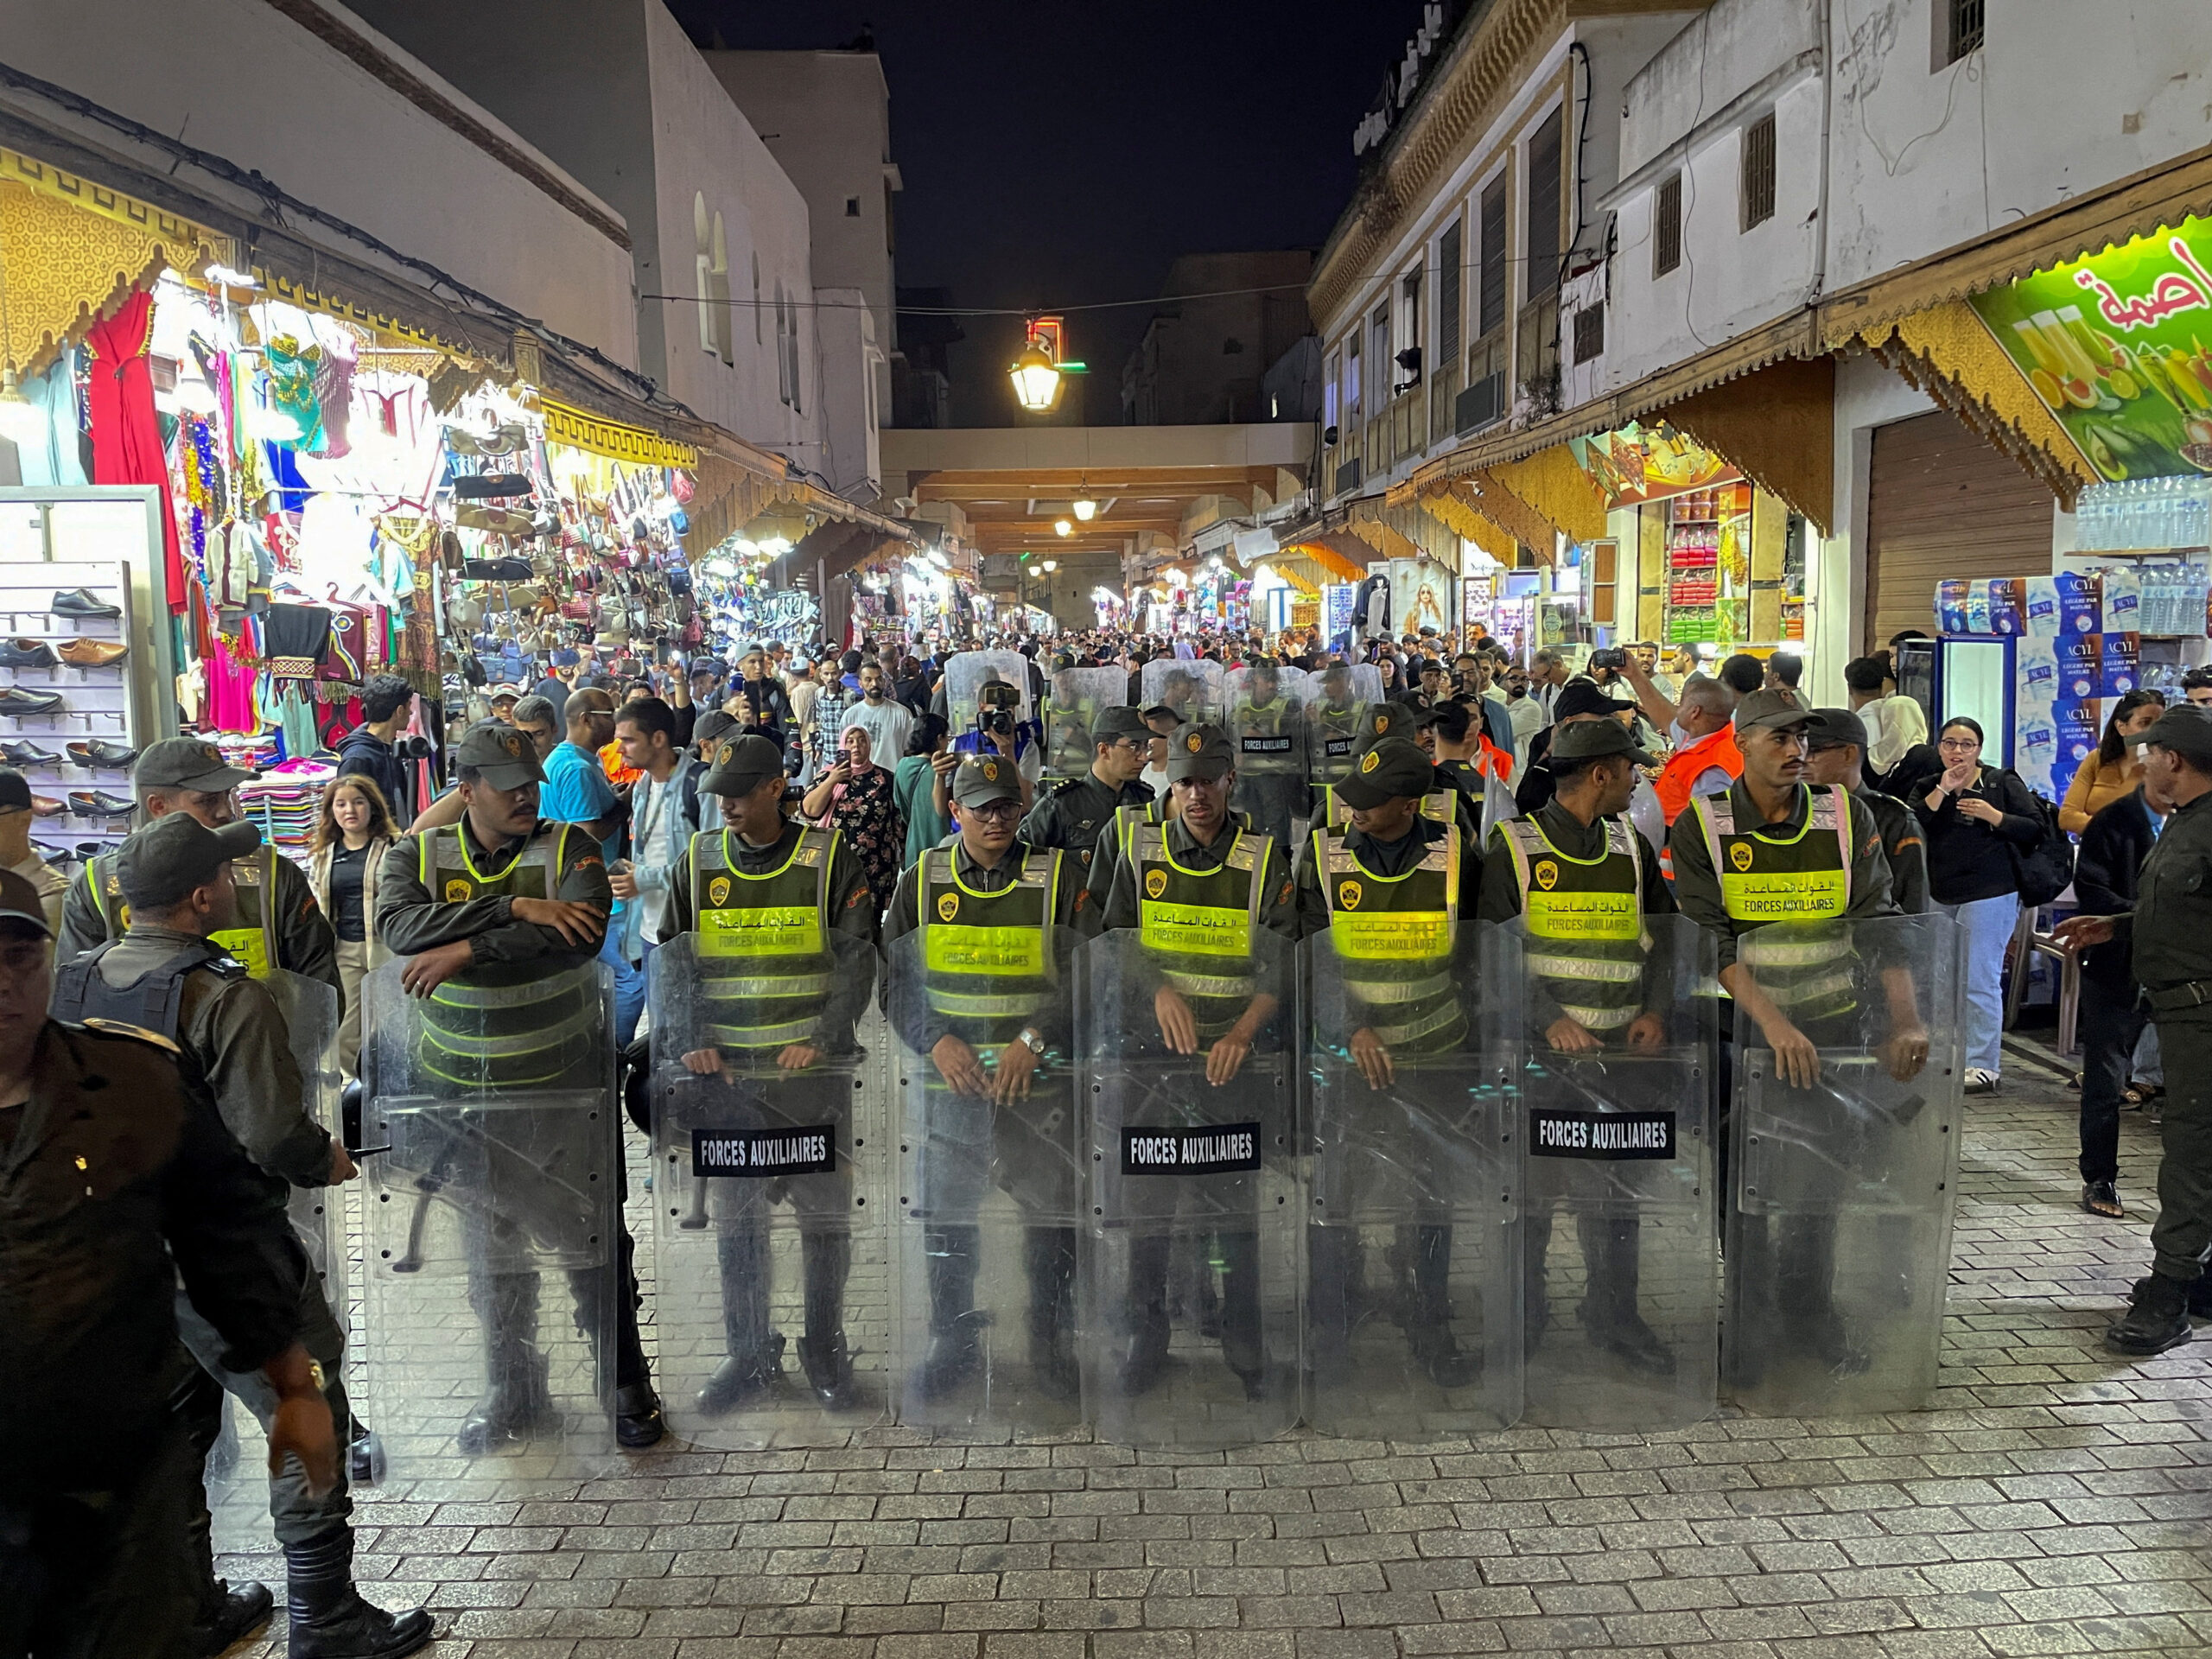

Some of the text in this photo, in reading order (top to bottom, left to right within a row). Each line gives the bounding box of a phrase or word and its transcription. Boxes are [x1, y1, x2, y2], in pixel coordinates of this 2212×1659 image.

[2066, 580, 2095, 591] ACYL
[2065, 645, 2094, 656] ACYL
[2106, 641, 2135, 653] ACYL
[2063, 709, 2093, 721] ACYL
[1244, 739, 1289, 750] FORCES AUXILIAIRES
[1328, 742, 1345, 753] FORCES
[1796, 880, 1834, 896] القوات
[1744, 898, 1834, 912] FORCES AUXILIAIRES
[1153, 912, 1199, 926] المساعدة
[1547, 918, 1630, 931] FORCES AUXILIAIRES
[719, 934, 753, 947] FORCES
[1153, 929, 1235, 948] FORCES AUXILIAIRES
[1351, 938, 1437, 950] FORCES AUXILIAIRES
[943, 952, 975, 965] FORCES
[1540, 1119, 1667, 1149] FORCES AUXILIAIRES
[701, 1135, 826, 1166] FORCES AUXILIAIRES
[1131, 1133, 1253, 1165] FORCES AUXILIAIRES
